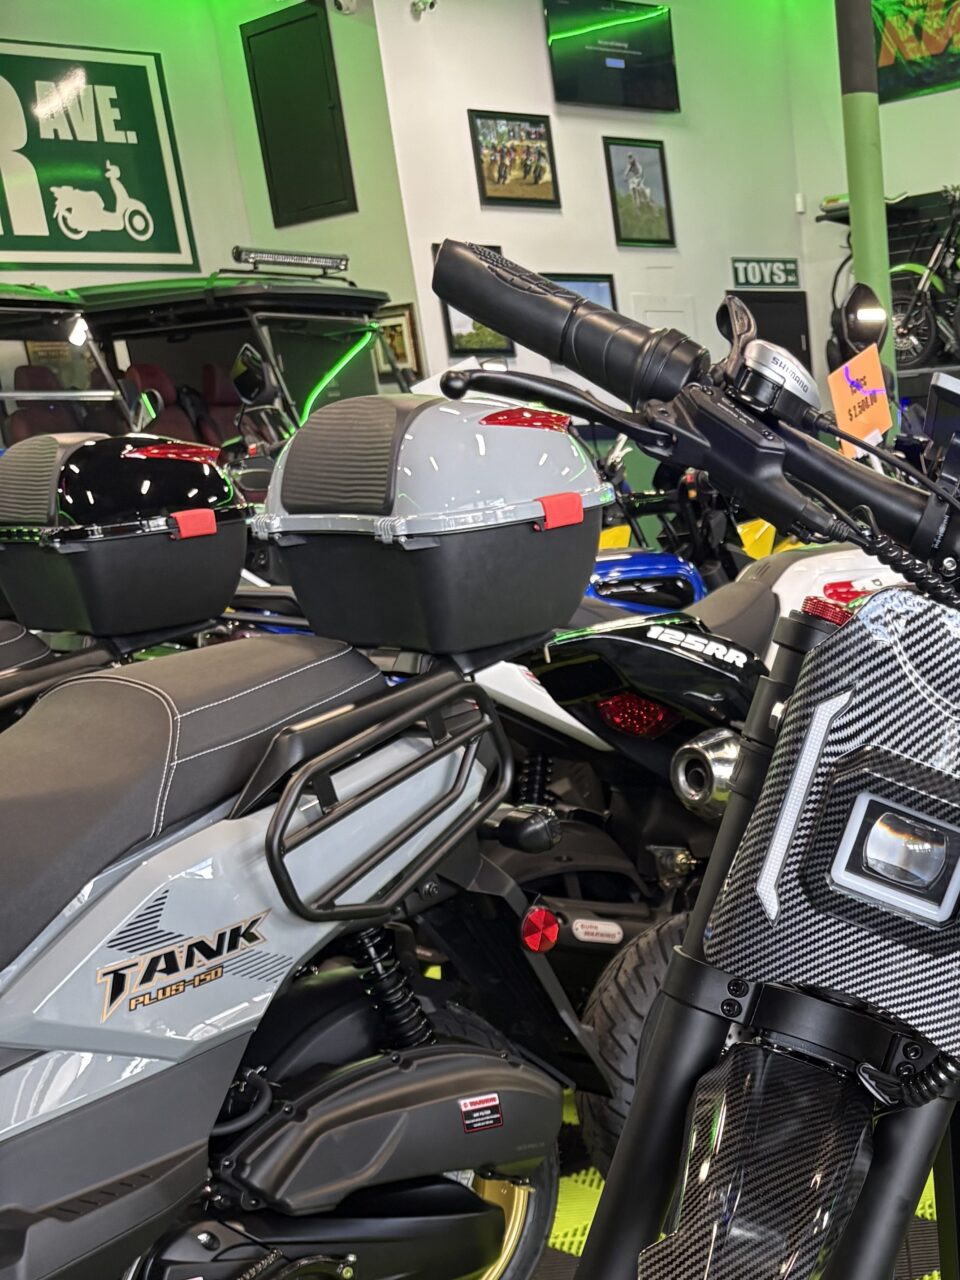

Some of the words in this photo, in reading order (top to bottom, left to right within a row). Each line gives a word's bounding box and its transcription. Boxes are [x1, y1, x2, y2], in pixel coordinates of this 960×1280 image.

[34, 66, 138, 144] AVE.
[735, 262, 786, 283] TOYS
[770, 356, 809, 394] SHIMANO
[646, 625, 748, 669] 125RR
[97, 908, 272, 1022] TANK
[129, 965, 223, 1012] PLUS-150
